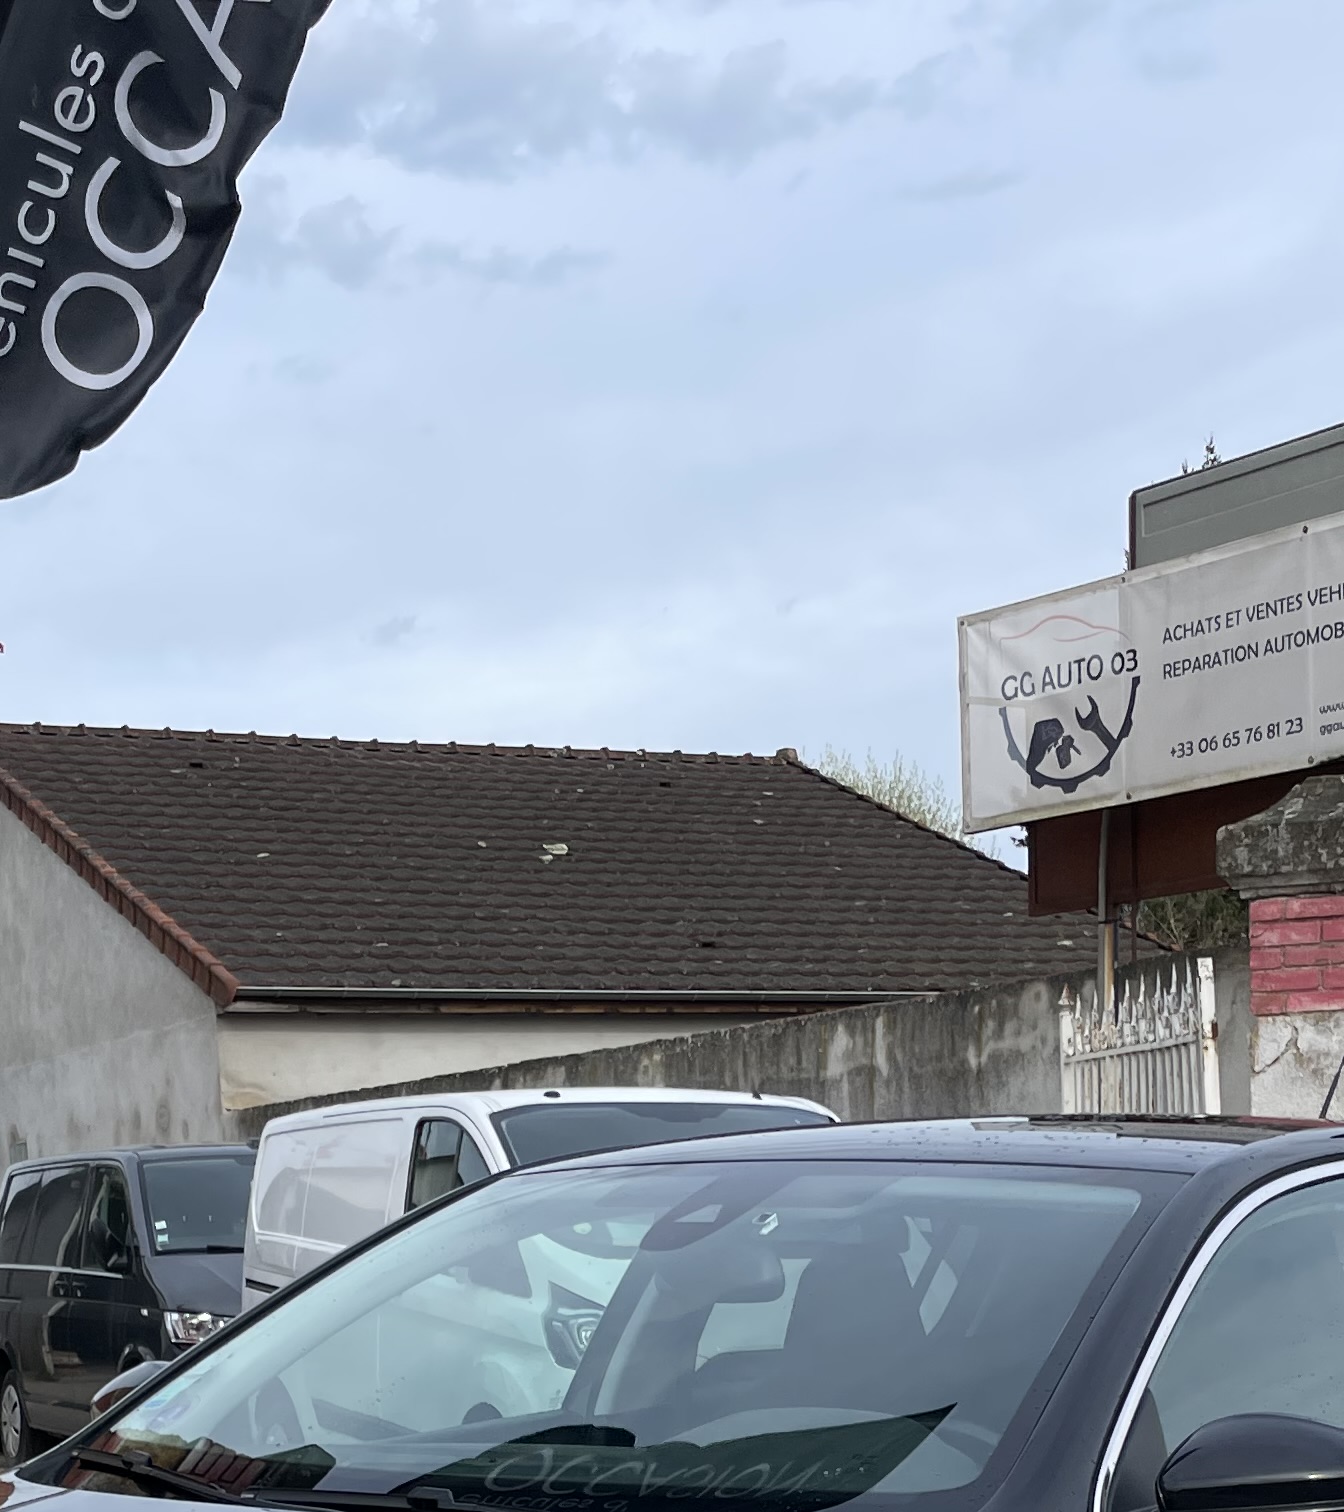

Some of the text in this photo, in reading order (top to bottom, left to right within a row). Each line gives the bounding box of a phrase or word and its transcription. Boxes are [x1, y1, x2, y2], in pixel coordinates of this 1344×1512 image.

[1162, 614, 1222, 645] ACHATS
[1225, 608, 1242, 629] ET
[1245, 592, 1303, 623] VENTES
[1001, 648, 1139, 701] GG AUTO 03
[1162, 641, 1260, 680] REPARATION
[1170, 716, 1304, 759] +33 06 65 76 81 23
